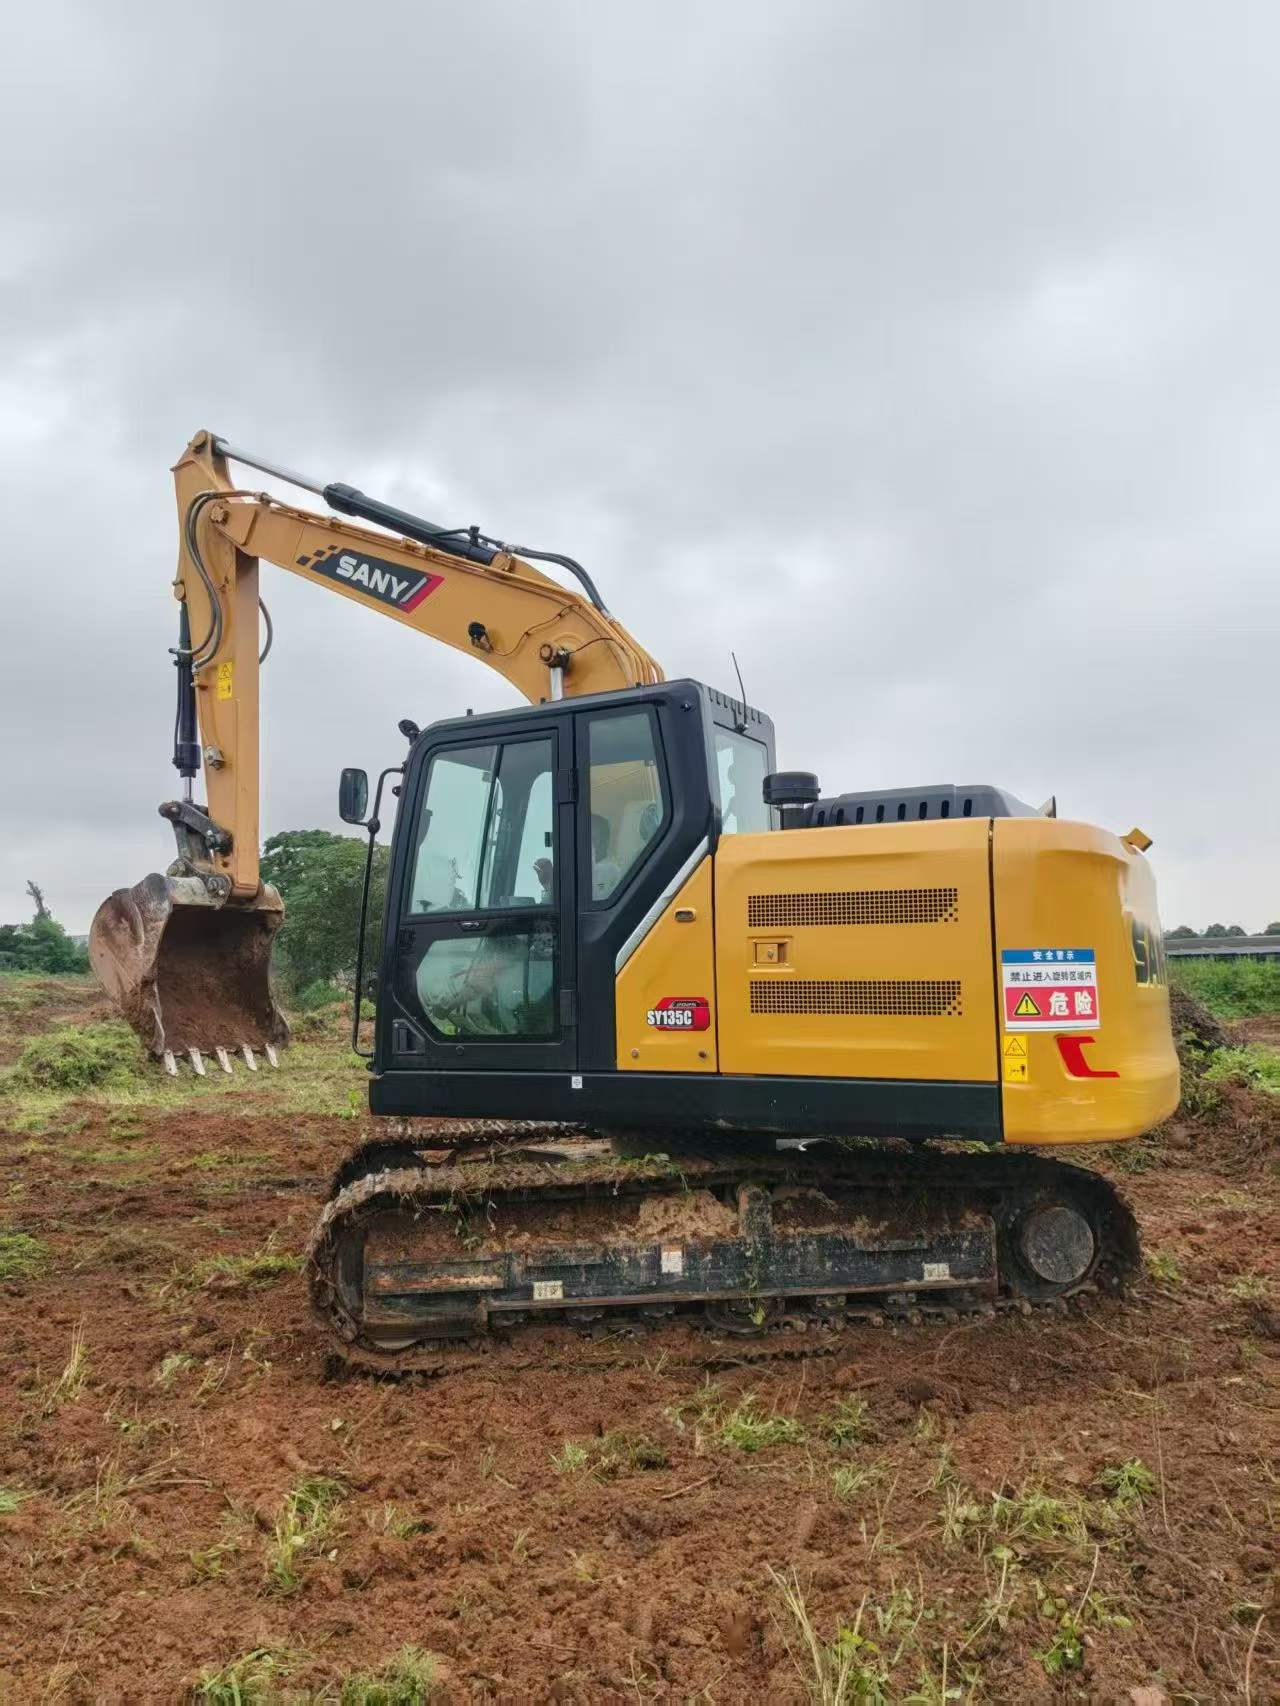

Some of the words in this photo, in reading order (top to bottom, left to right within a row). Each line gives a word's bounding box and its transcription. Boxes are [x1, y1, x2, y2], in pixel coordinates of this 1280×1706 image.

[336, 555, 409, 599] SANY
[1032, 950, 1075, 960] 安全警示
[1048, 990, 1093, 1015] 危险
[647, 1009, 692, 1025] SY135C
